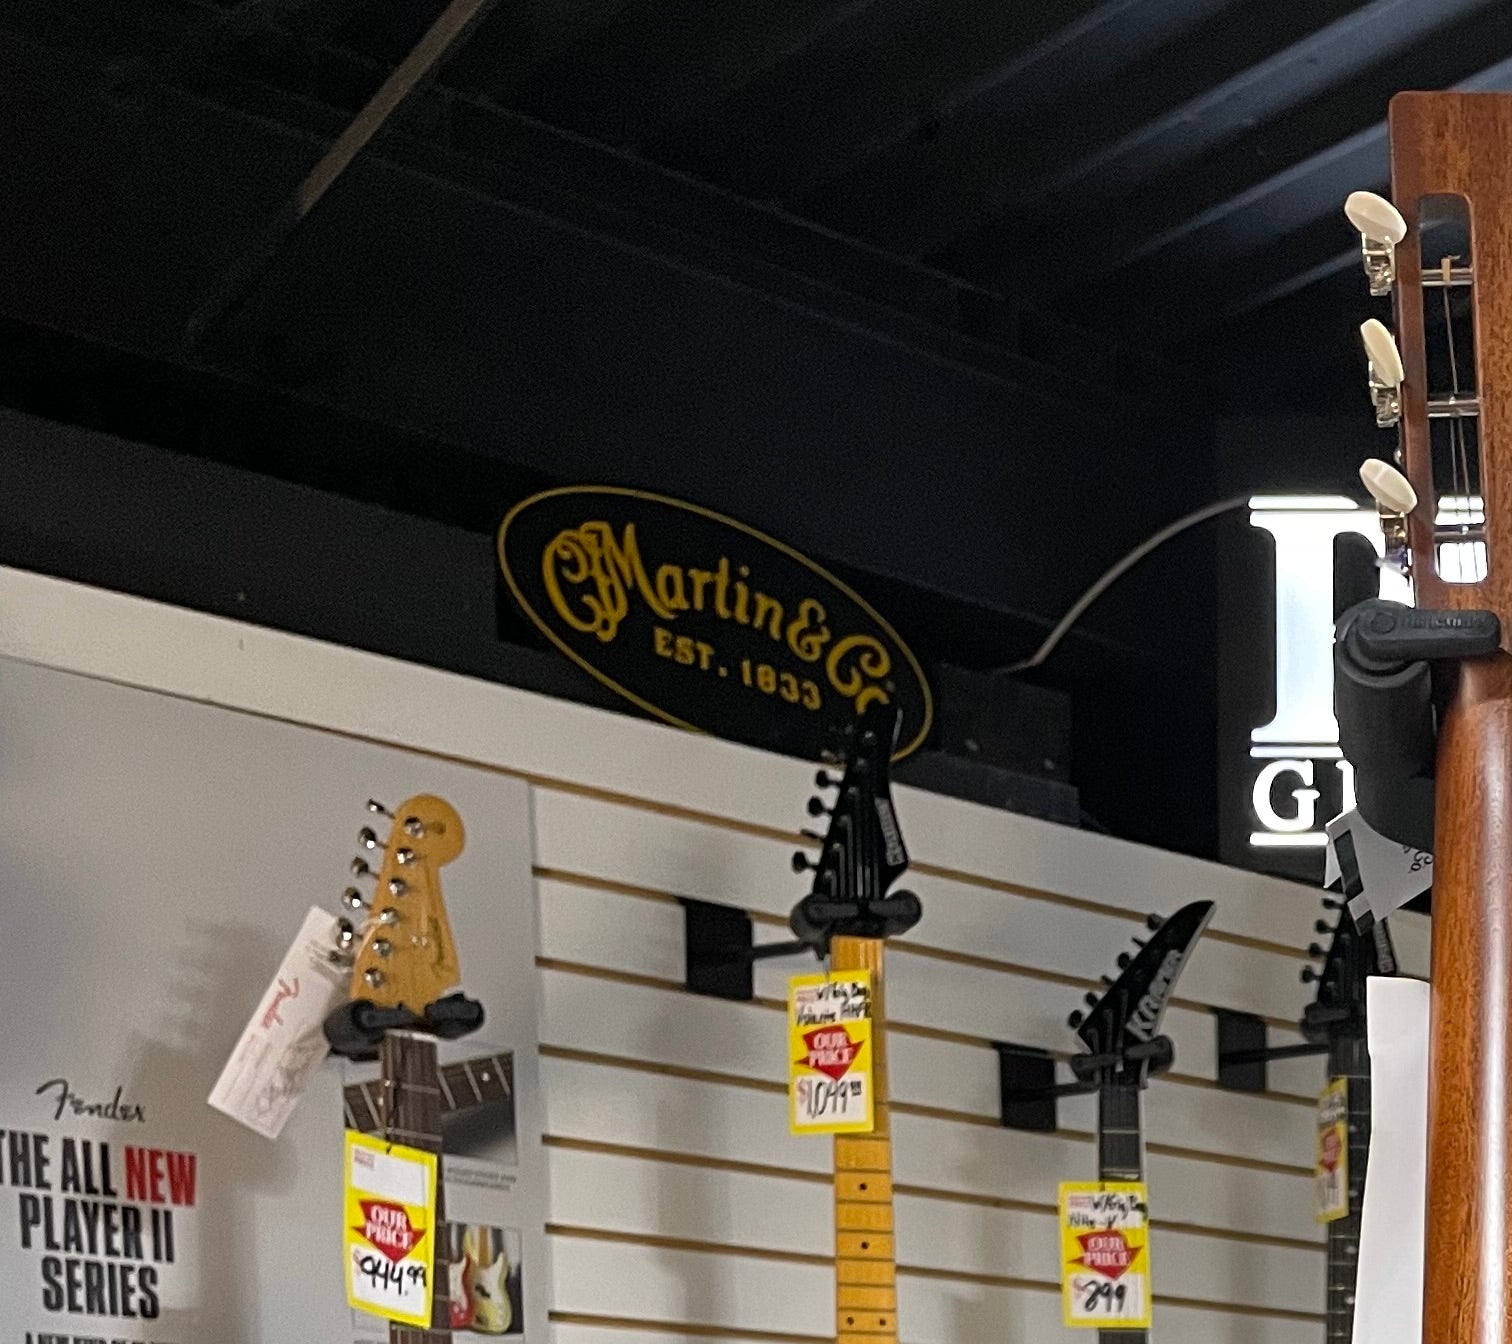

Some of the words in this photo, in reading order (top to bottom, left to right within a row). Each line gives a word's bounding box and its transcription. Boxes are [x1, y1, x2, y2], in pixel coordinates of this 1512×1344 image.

[814, 1031, 848, 1050] OUR
[808, 1046, 854, 1068] PRICE
[36, 1078, 146, 1123] Fender
[61, 1136, 117, 1198] ALL
[124, 1144, 197, 1208] NEW
[18, 1192, 144, 1261] PLAYER
[151, 1207, 175, 1264] II
[371, 1205, 408, 1229] OUR
[365, 1220, 414, 1251] PRICE
[1087, 1236, 1125, 1251] OUR
[1083, 1250, 1130, 1267] PRICE
[41, 1255, 160, 1320] SERIES
